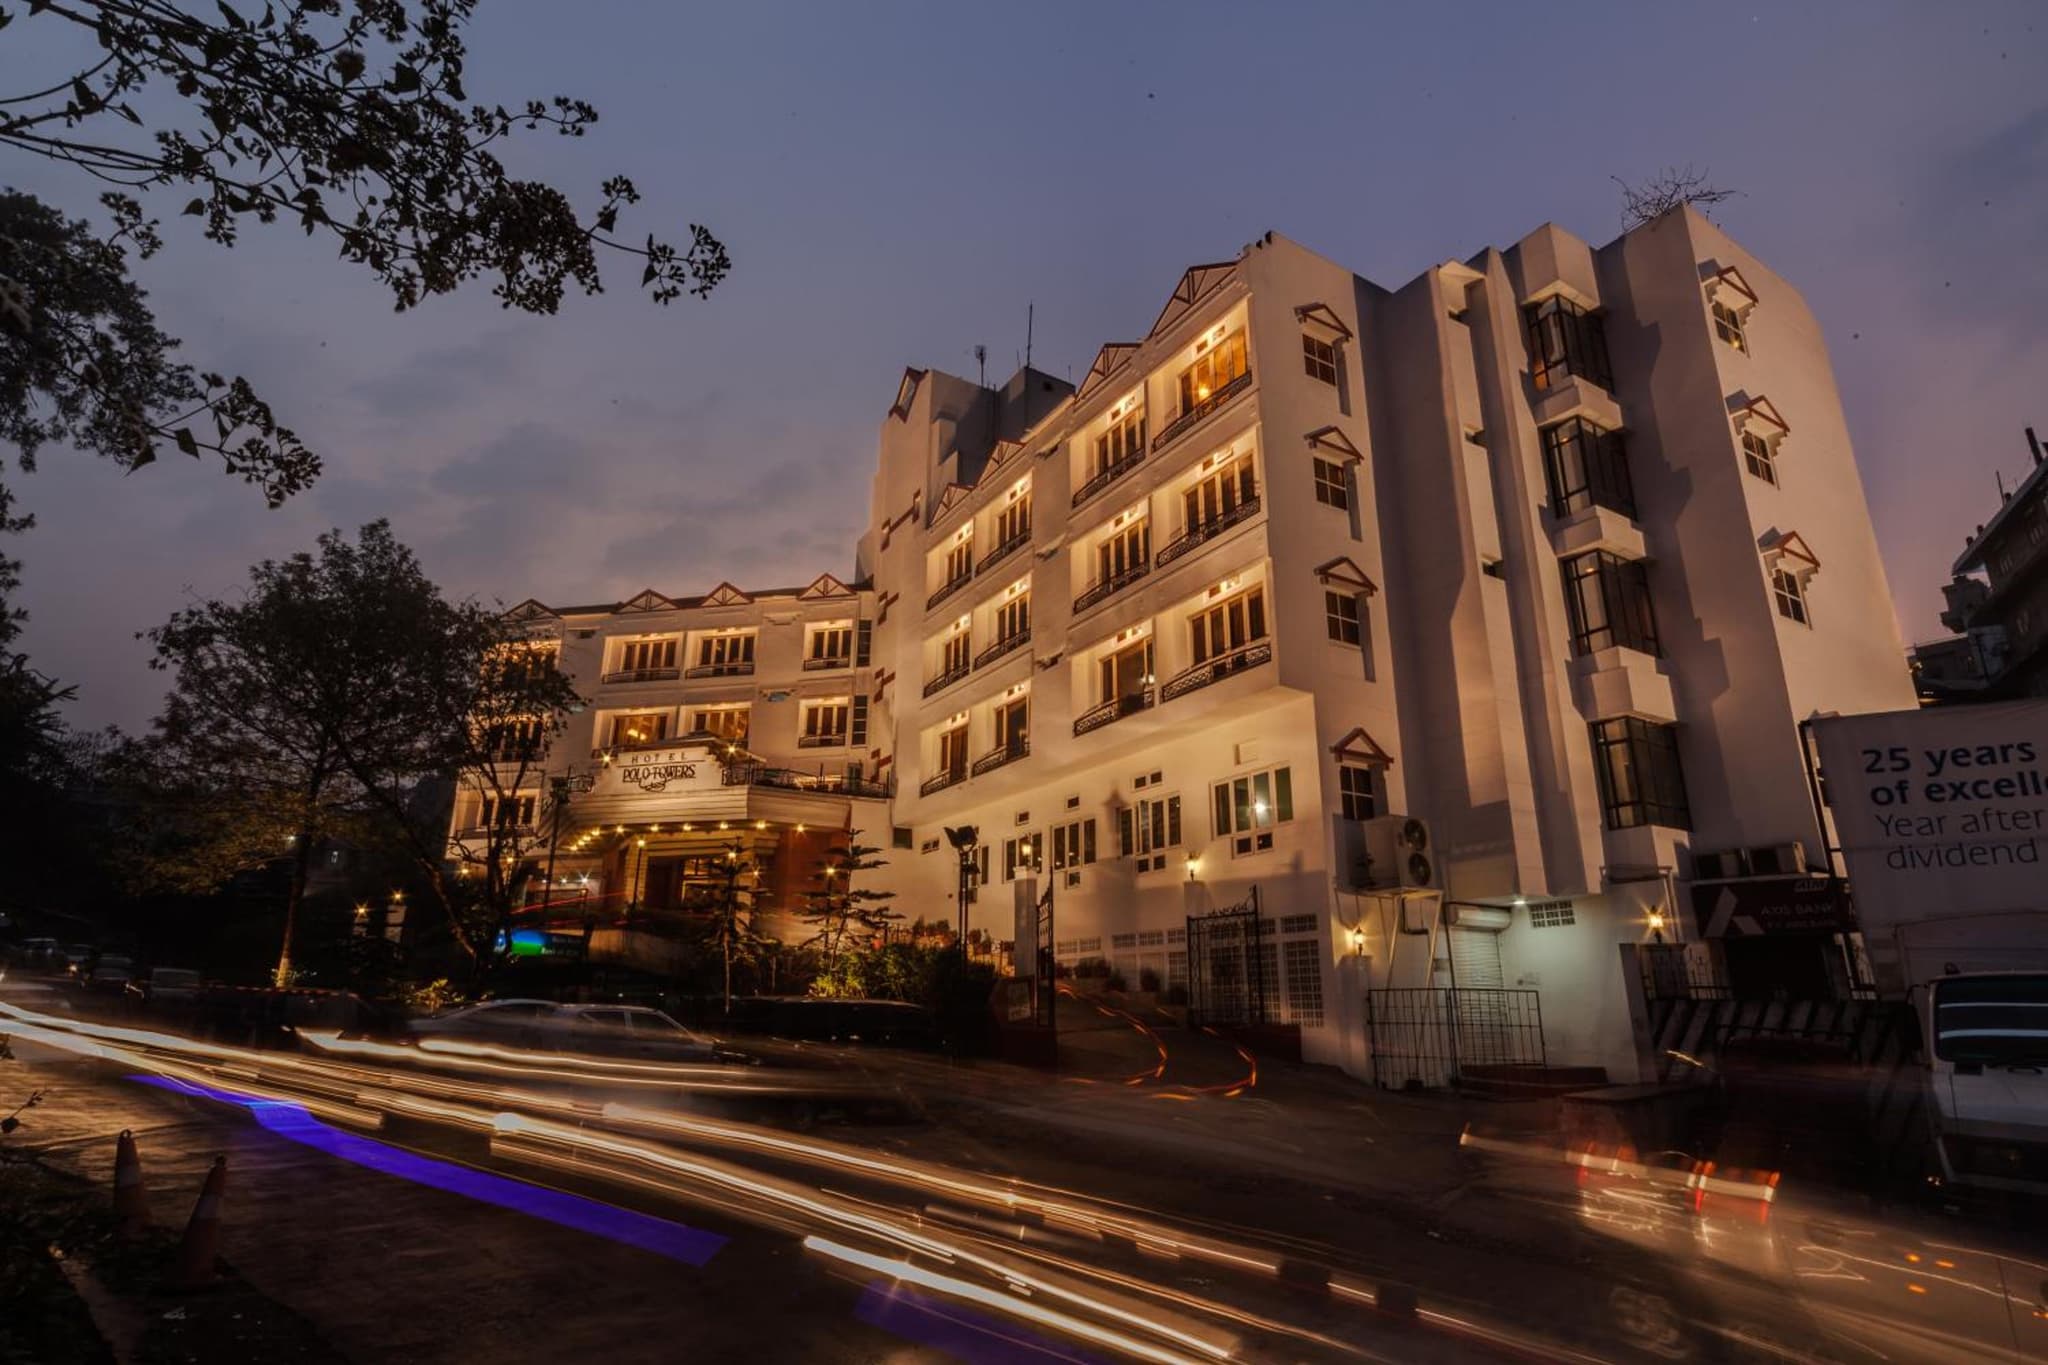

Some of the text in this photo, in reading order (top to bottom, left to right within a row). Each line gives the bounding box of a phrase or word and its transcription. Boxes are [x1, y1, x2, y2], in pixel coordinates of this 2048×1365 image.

[632, 752, 688, 764] HOTEL
[1862, 742, 2036, 776] 25 years
[623, 764, 696, 782] POLO TOWERS
[1872, 780, 1910, 805] of
[1876, 808, 2046, 837] Year after
[1887, 839, 2038, 870] dividend
